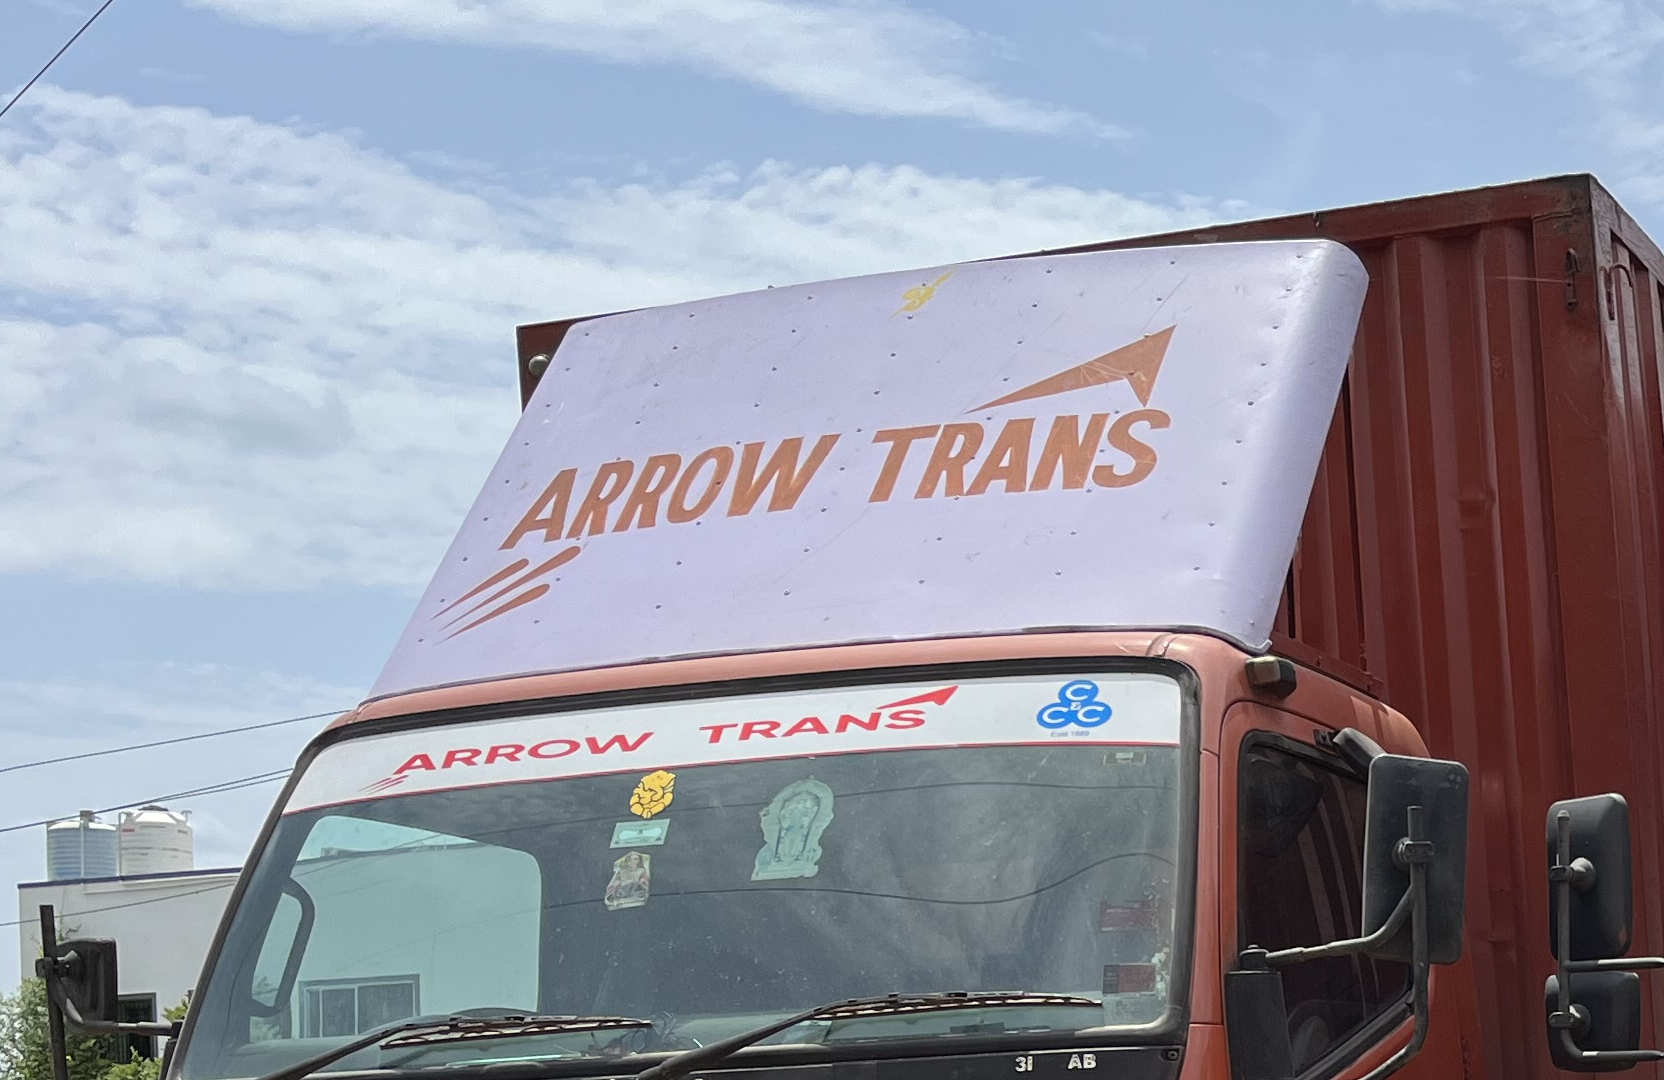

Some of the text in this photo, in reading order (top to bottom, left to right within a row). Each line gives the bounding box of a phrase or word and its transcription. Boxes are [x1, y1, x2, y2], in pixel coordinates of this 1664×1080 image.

[500, 407, 1171, 550] ARROW TRANS
[393, 708, 926, 775] ARROW TRANS
[1067, 1053, 1097, 1070] AB
